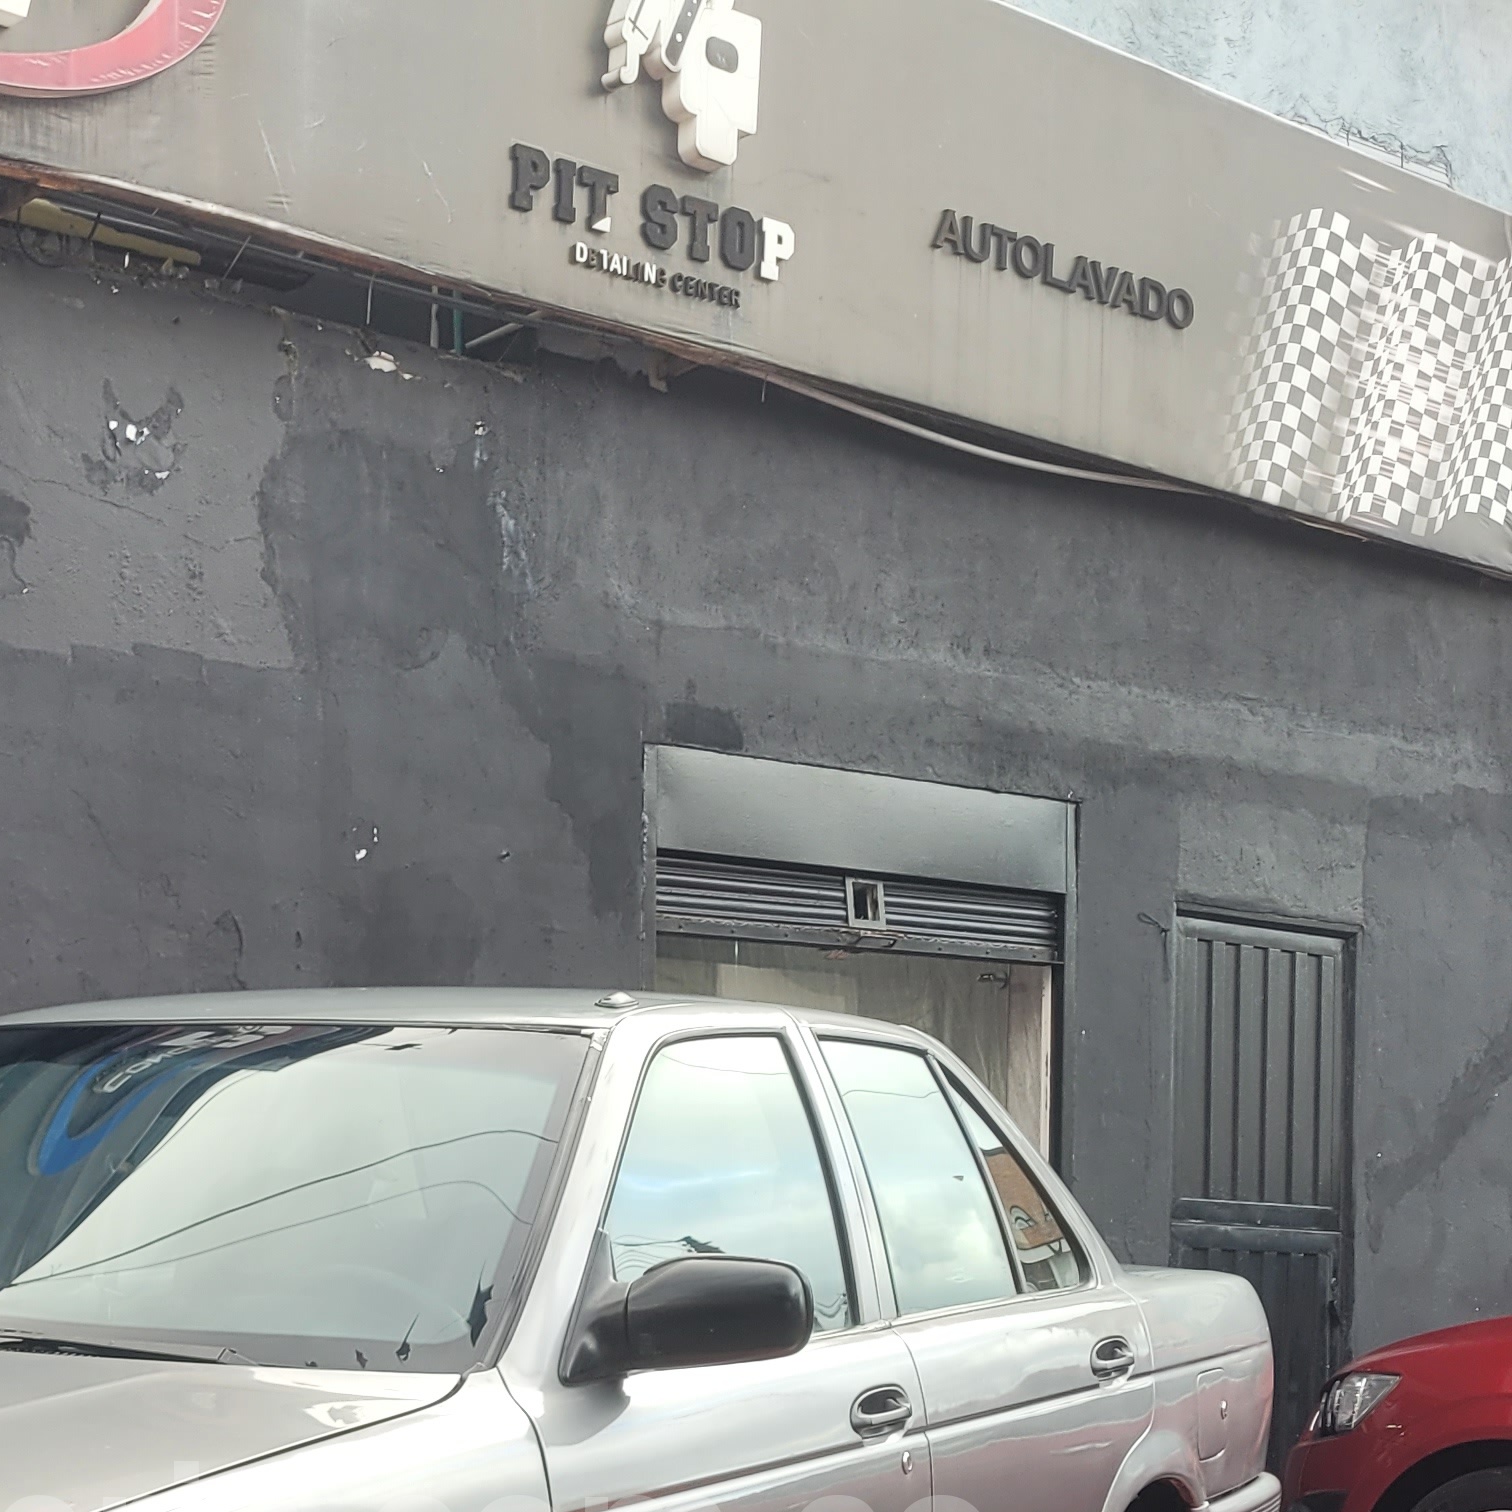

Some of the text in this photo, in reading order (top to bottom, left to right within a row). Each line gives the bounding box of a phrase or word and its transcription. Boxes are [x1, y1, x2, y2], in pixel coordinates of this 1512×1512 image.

[508, 142, 795, 281] PIT STOP
[931, 208, 1194, 329] AUTOLAVADO
[669, 272, 741, 308] CENTER
